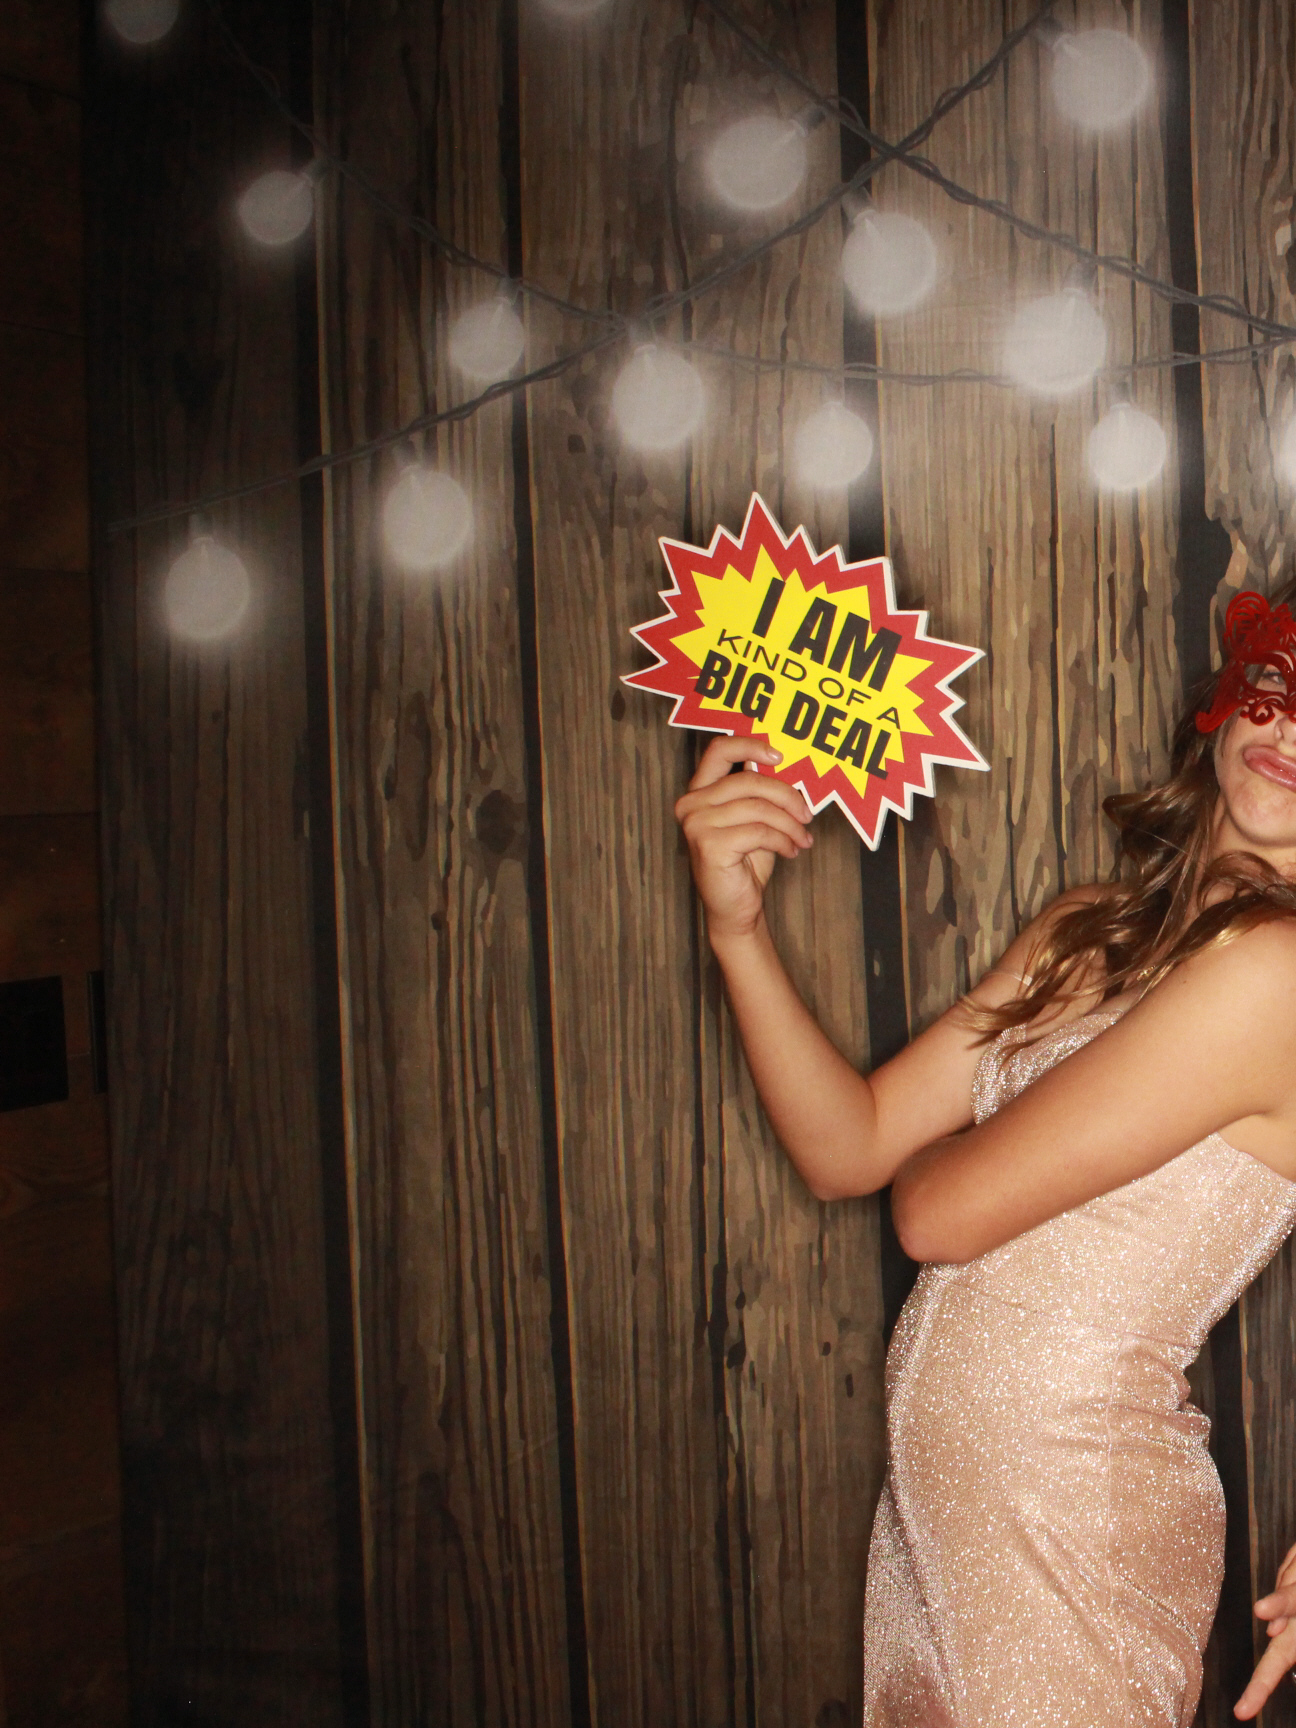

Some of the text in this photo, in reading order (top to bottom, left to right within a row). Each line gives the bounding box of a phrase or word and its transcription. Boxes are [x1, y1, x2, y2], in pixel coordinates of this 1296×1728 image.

[717, 628, 901, 730] KIND OF A
[752, 577, 903, 692] I AM
[694, 649, 892, 780] BIG DEAL
